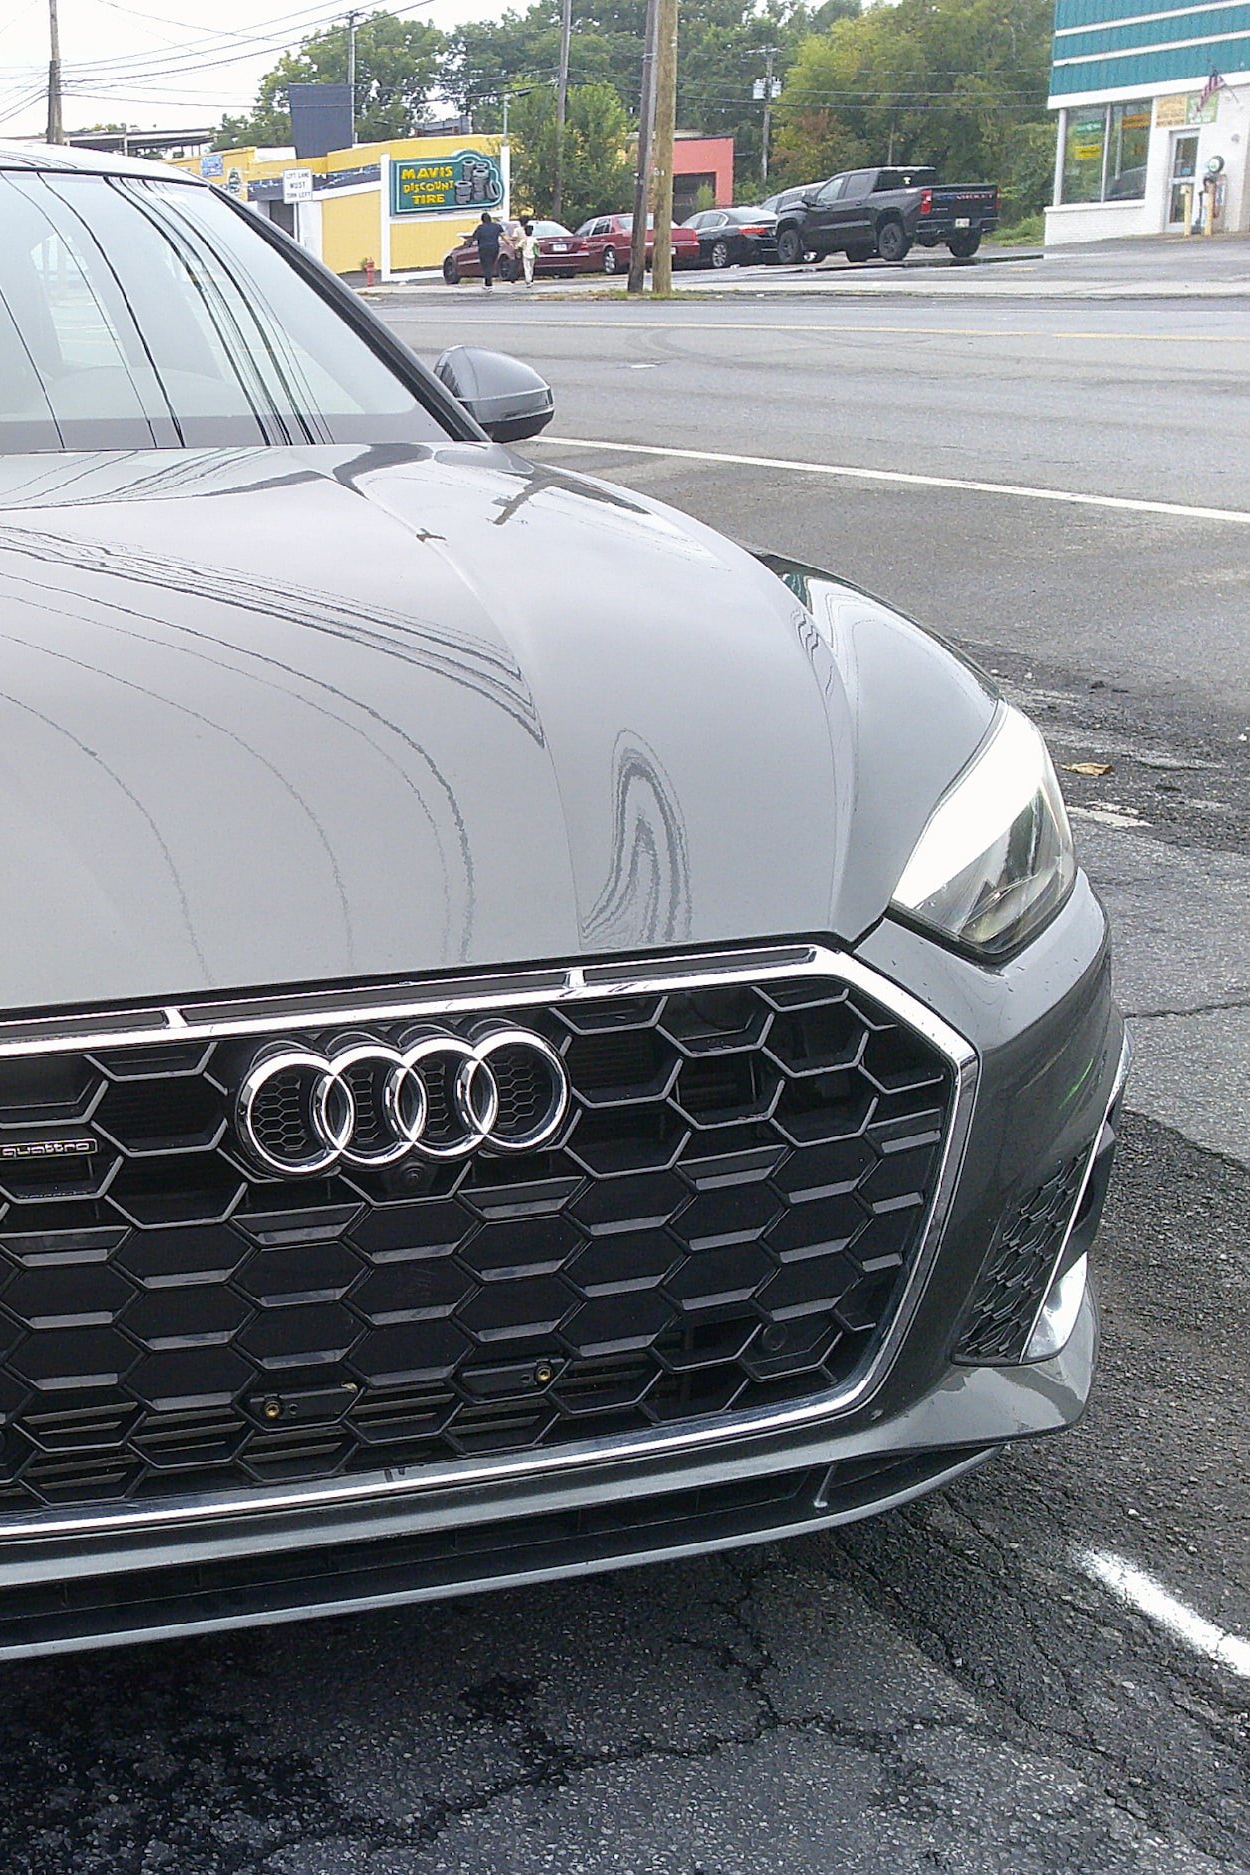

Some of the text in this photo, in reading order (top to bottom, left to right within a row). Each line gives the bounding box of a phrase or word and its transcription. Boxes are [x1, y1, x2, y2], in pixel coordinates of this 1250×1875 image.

[401, 165, 453, 179] MAVIS
[403, 180, 454, 193] DISCOUNT
[411, 193, 446, 205] TIRE
[2, 1142, 90, 1158] quattro
